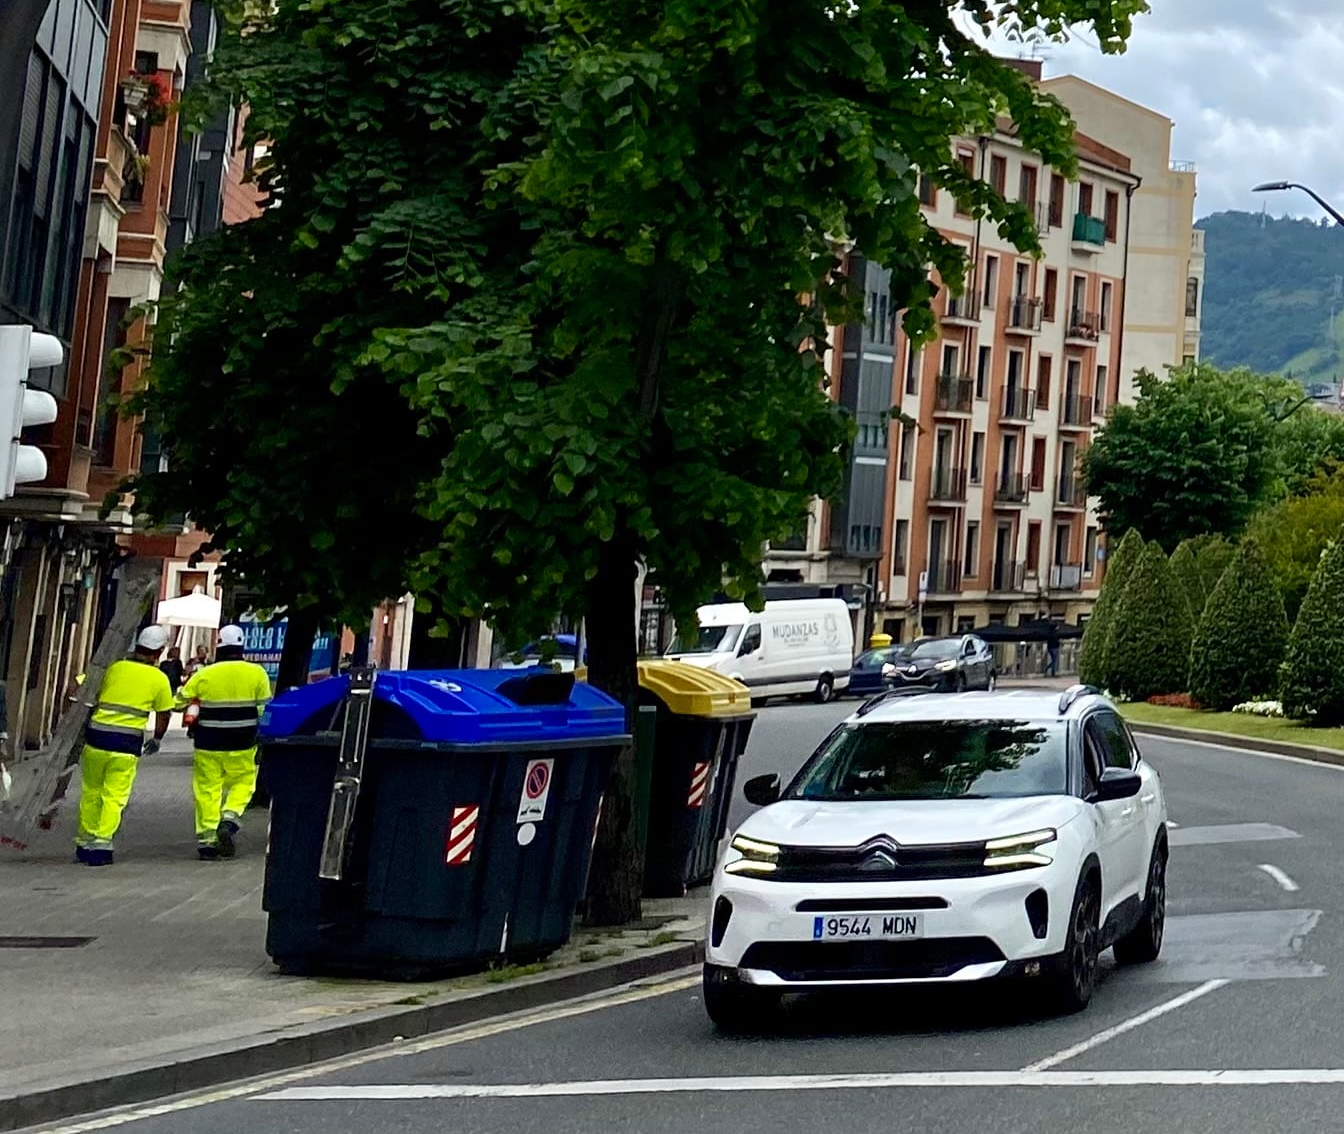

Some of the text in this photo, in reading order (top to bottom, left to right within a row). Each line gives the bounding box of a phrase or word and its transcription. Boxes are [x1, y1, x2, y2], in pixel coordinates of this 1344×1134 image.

[772, 623, 819, 638] MUDANZAS
[827, 916, 916, 936] 9544 MDN
